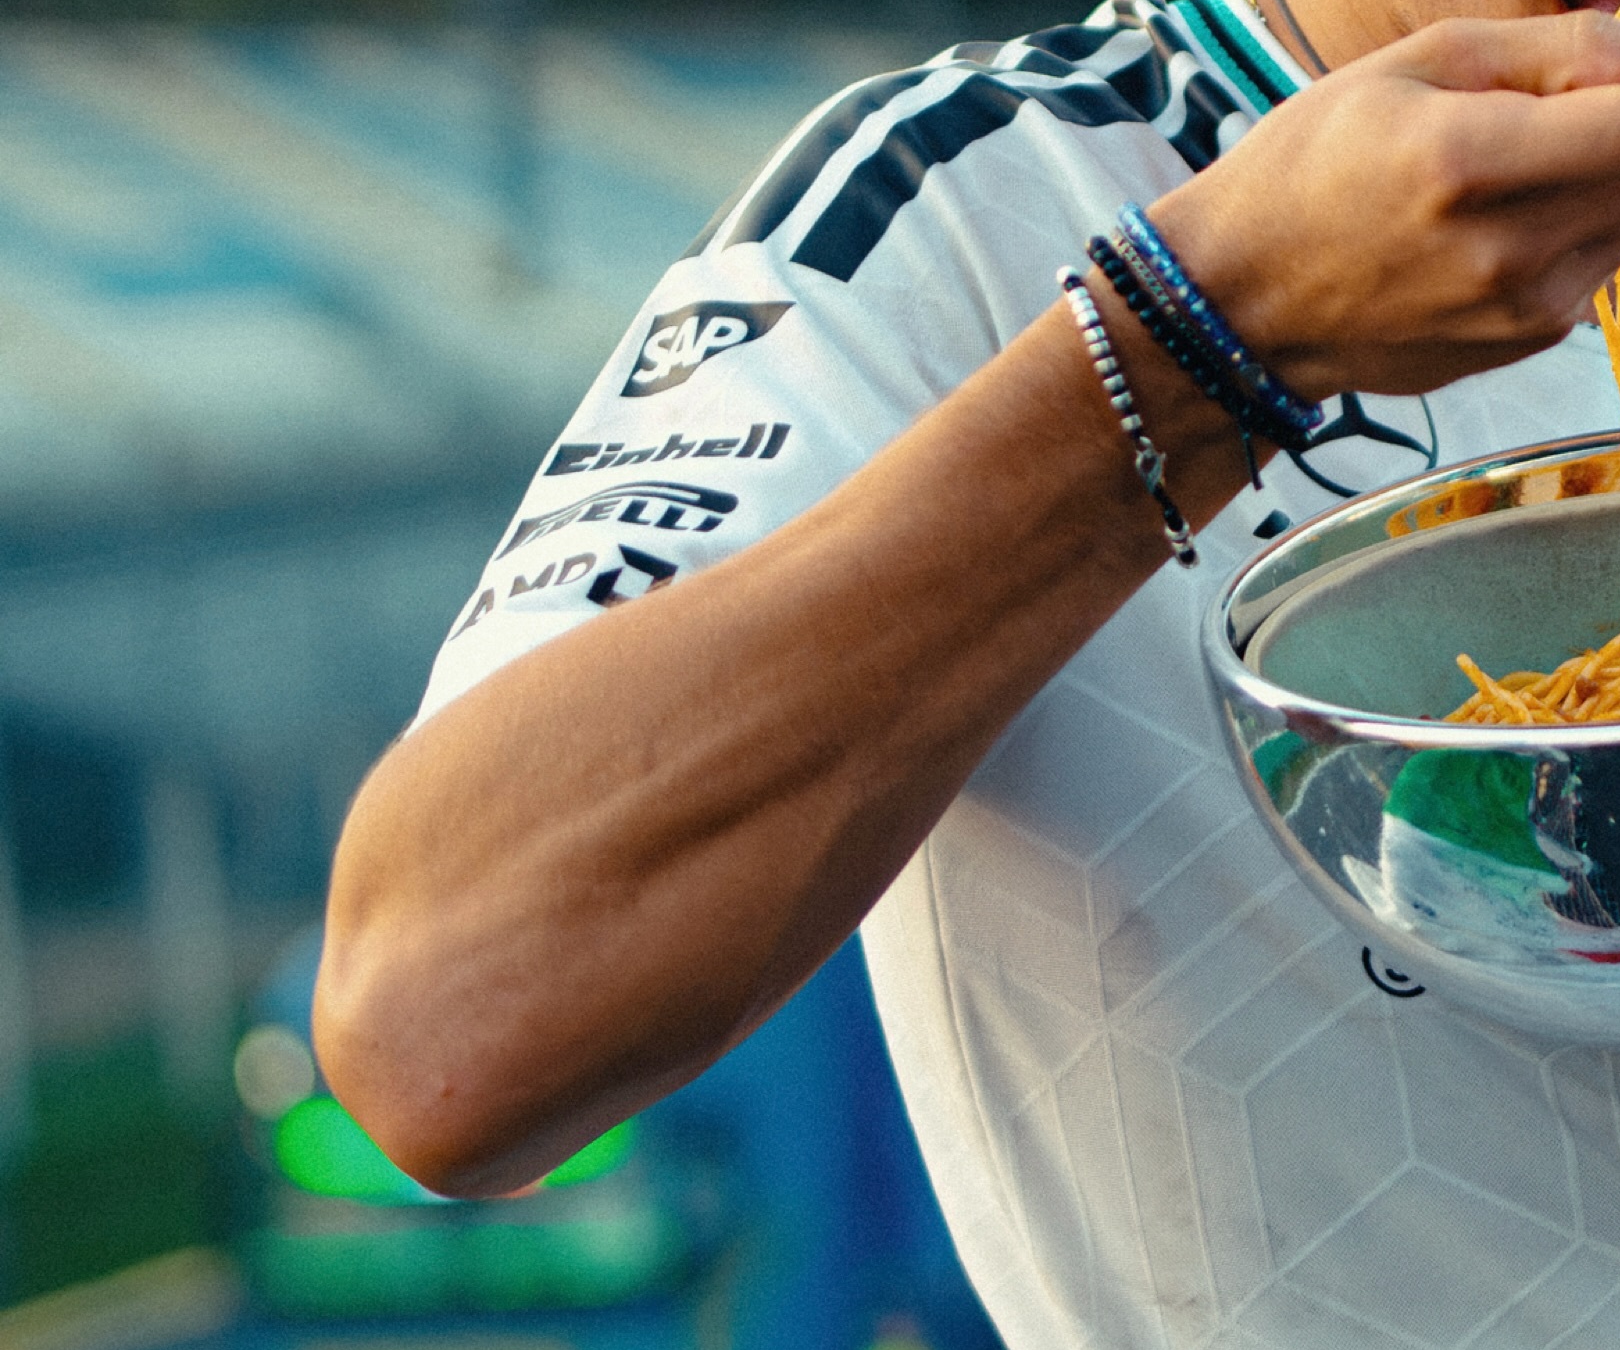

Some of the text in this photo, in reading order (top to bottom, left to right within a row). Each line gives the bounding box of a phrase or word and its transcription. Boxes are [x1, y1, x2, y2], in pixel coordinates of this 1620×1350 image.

[631, 314, 748, 383] SAP
[543, 423, 792, 476] Einhell
[494, 481, 738, 561] PIRELLI
[448, 552, 597, 642] AMD
